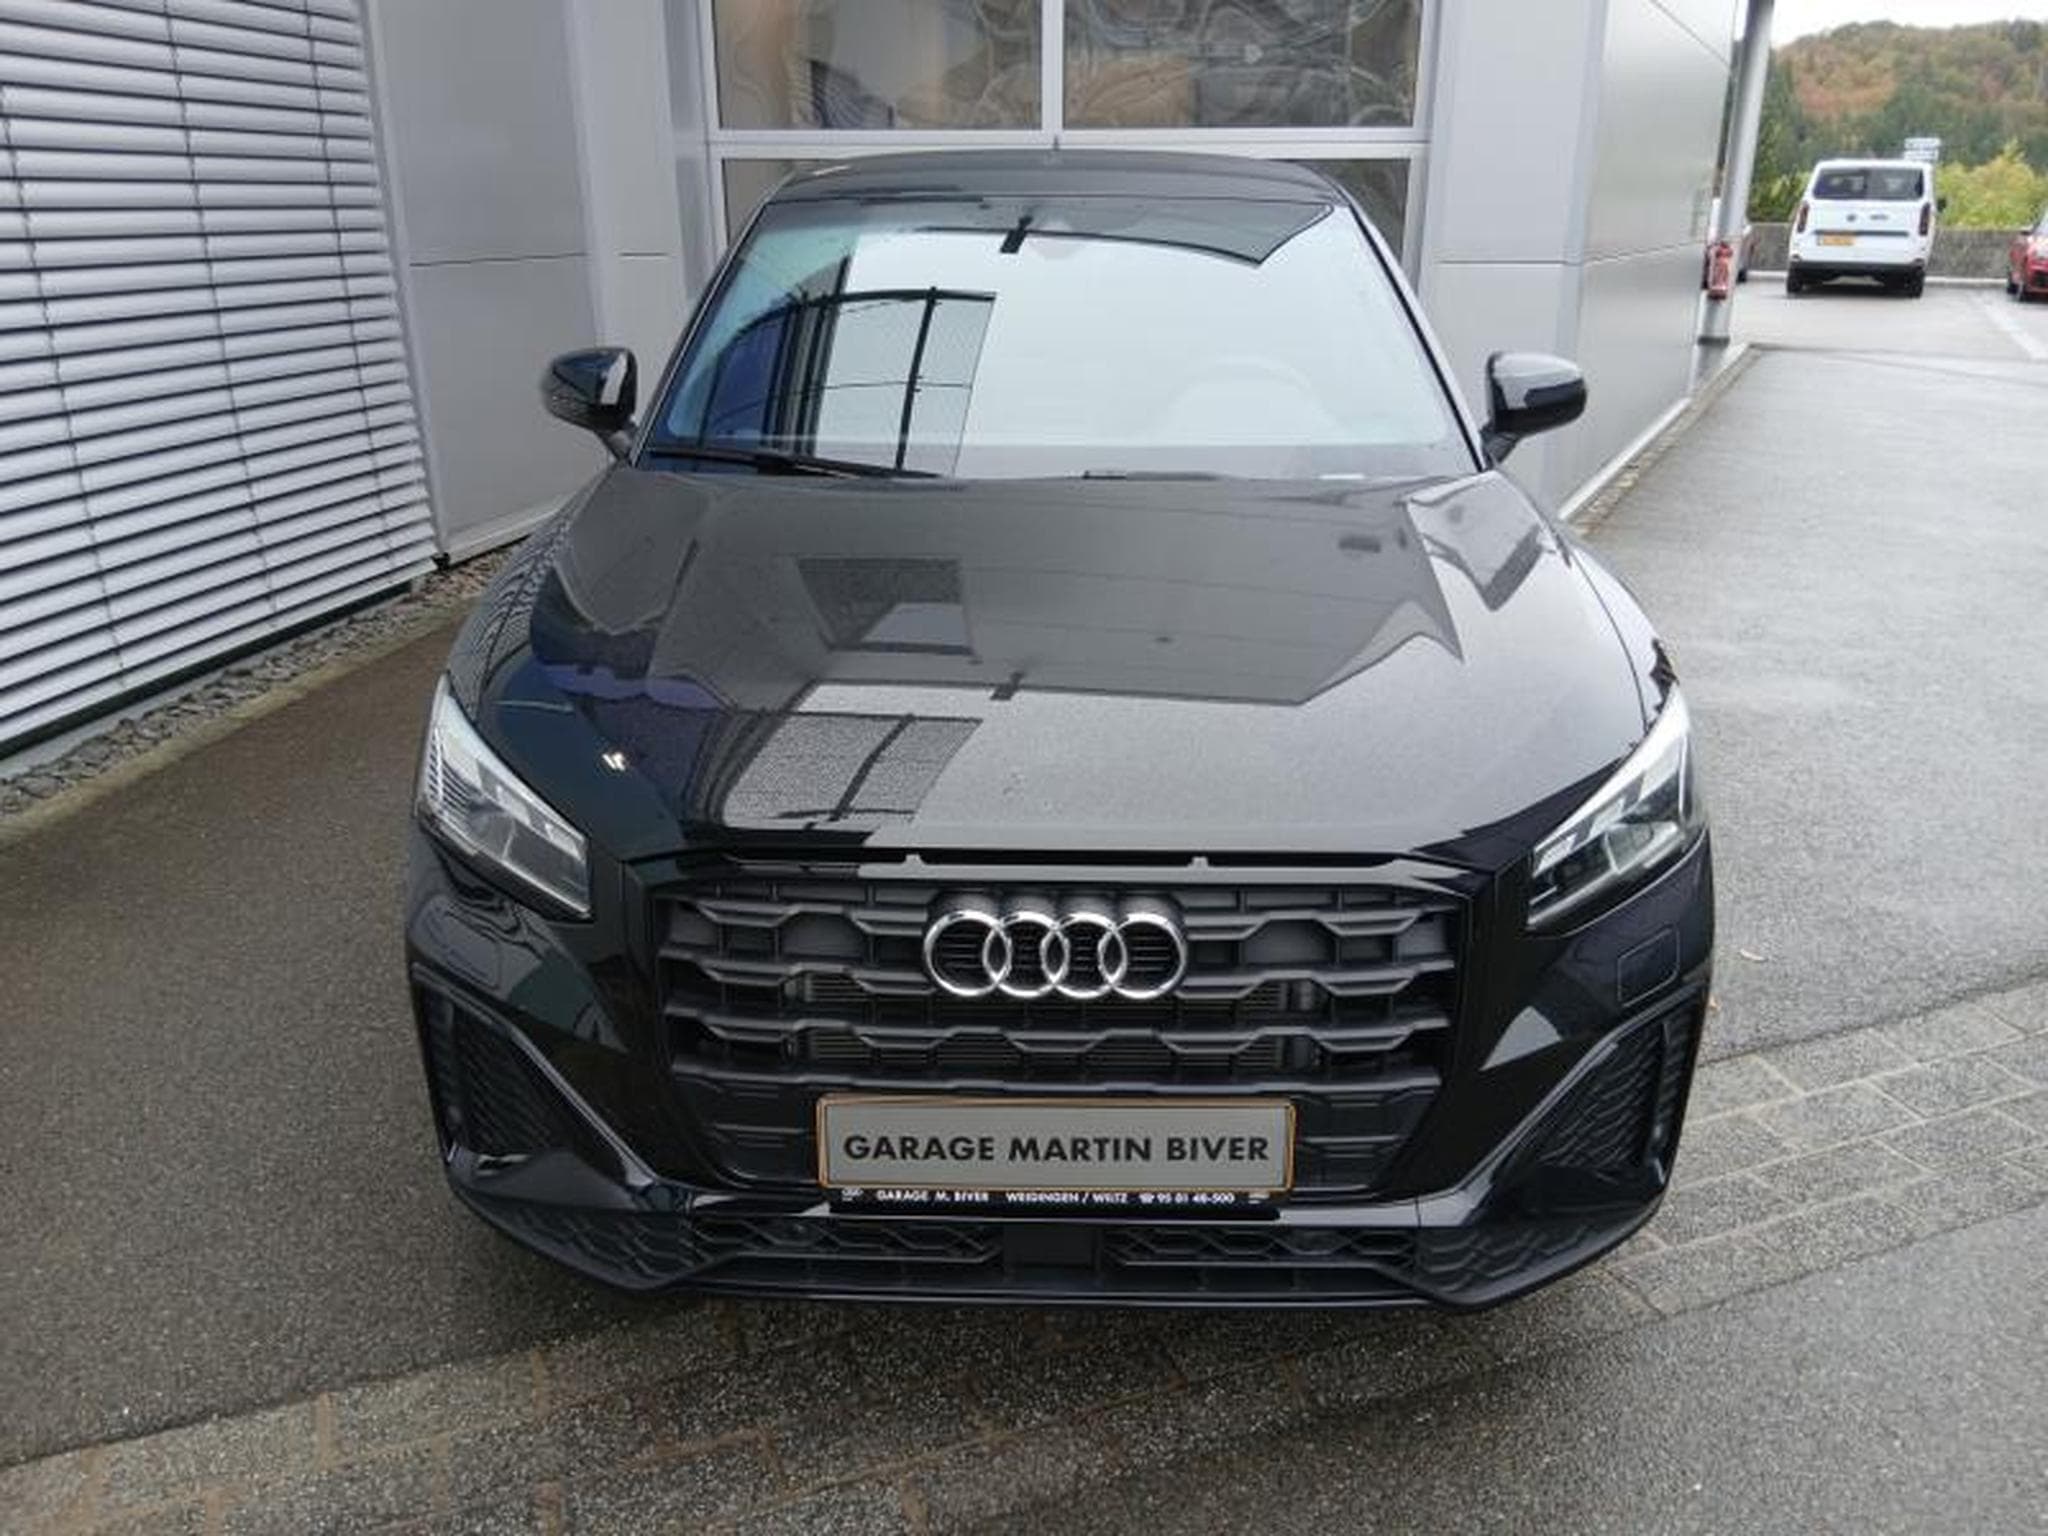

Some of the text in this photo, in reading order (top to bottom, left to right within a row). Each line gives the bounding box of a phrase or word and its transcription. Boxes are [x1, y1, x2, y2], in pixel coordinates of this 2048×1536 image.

[842, 1134, 1269, 1162] GARAGE MARTIN BIVER
[876, 1190, 929, 1201] GARAGE
[953, 1191, 989, 1202] BIVER
